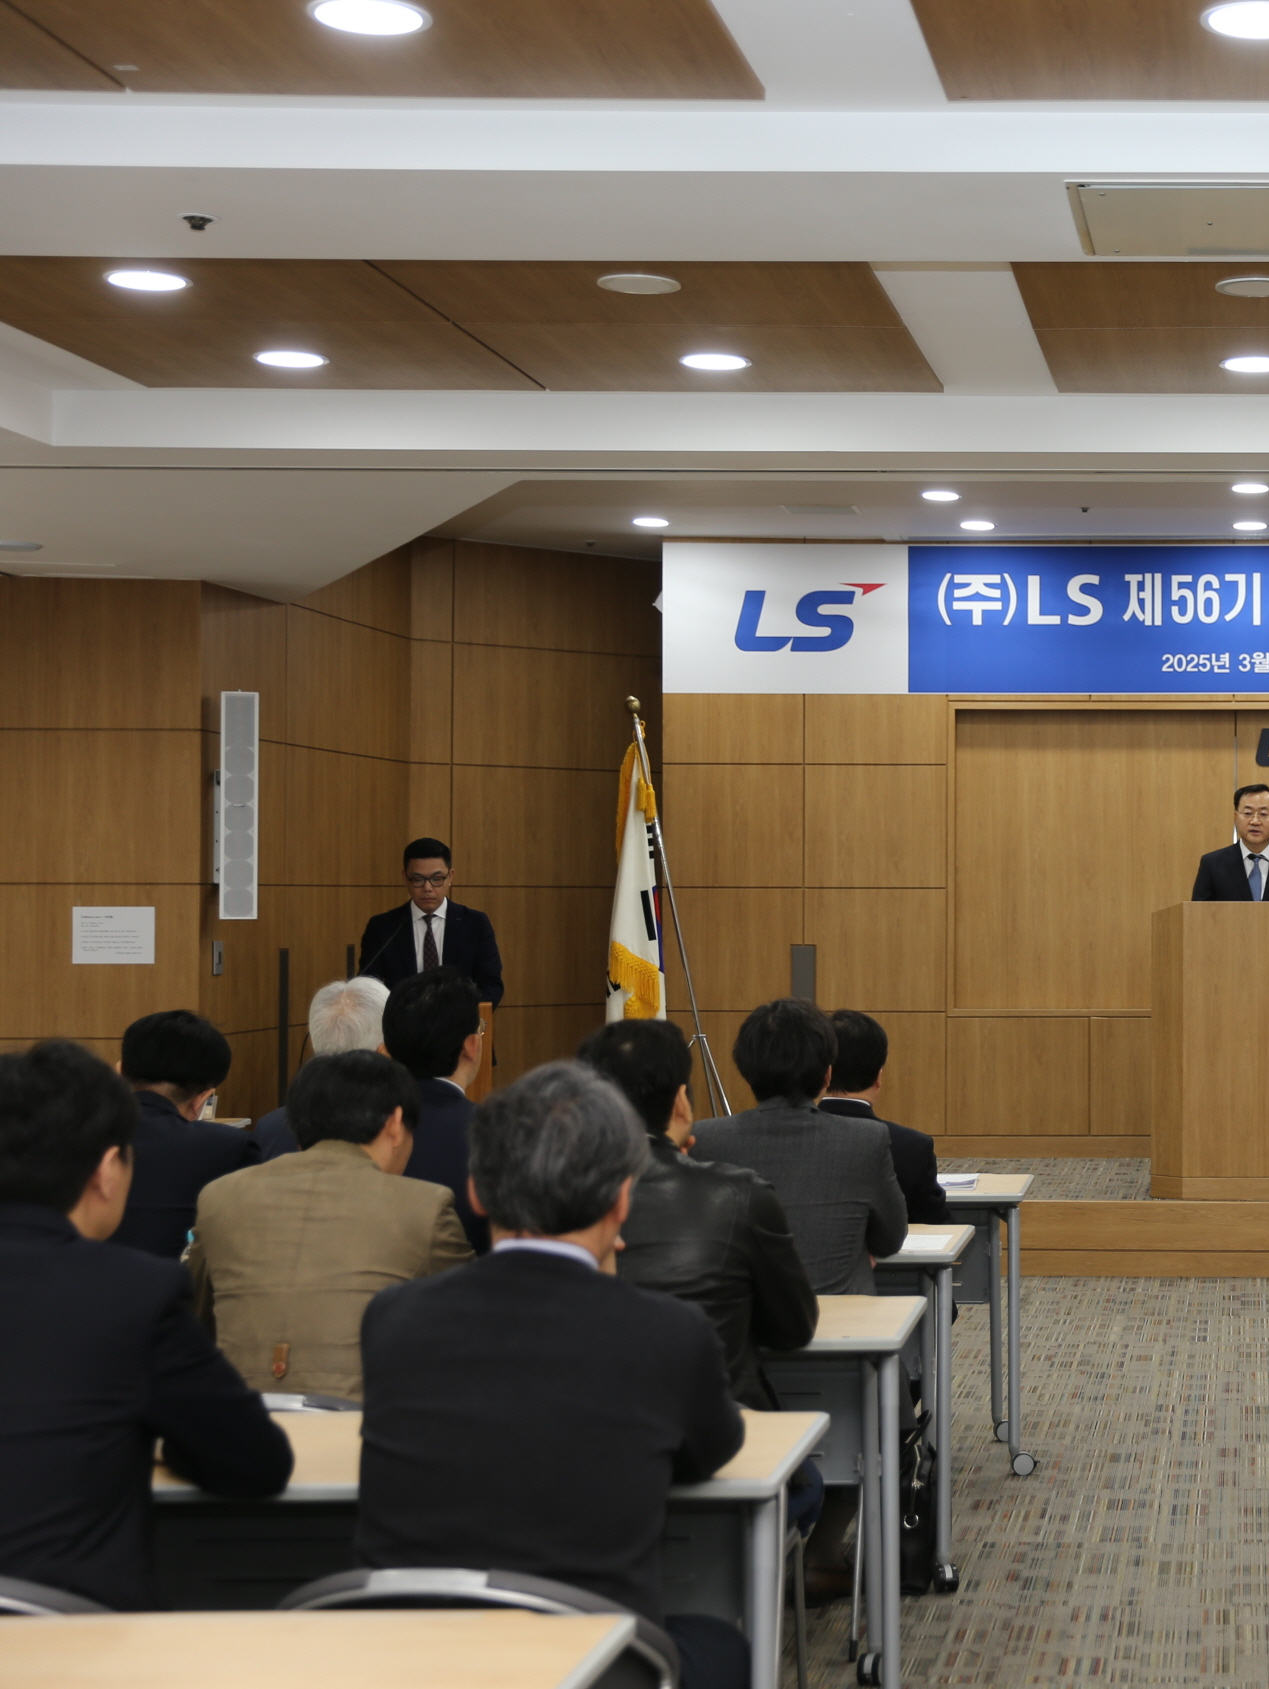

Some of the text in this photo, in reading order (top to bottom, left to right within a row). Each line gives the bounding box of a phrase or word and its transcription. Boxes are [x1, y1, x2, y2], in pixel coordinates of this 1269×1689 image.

[734, 590, 856, 652] LS
[937, 572, 1104, 626] (주)LS
[1123, 572, 1262, 626] 제56기
[1161, 652, 1230, 673] 2025년
[1238, 652, 1269, 673] 3월
